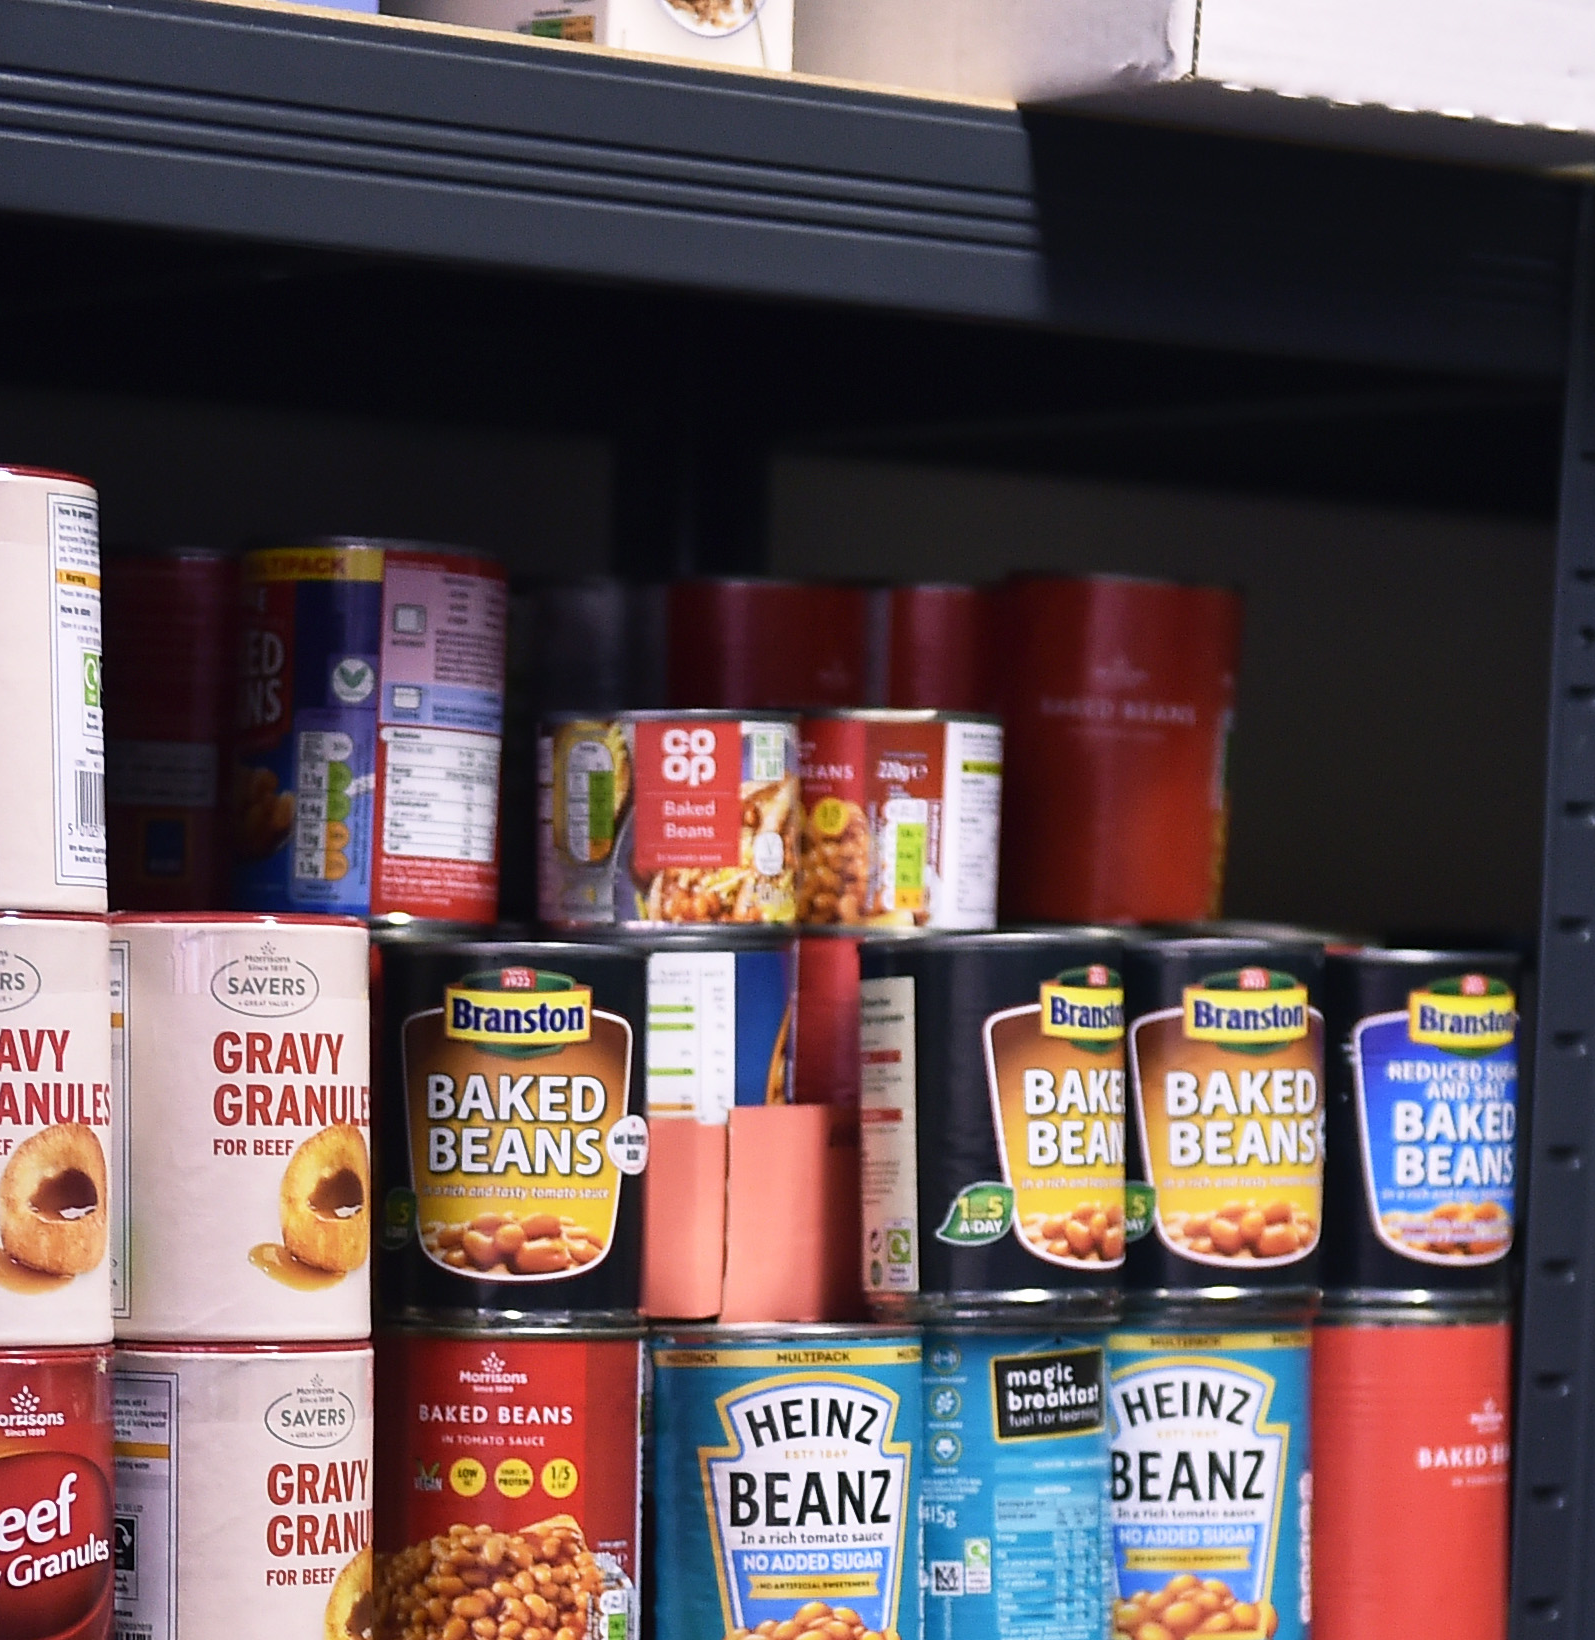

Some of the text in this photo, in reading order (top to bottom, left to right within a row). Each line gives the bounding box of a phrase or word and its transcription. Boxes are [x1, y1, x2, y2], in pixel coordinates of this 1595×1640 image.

[663, 801, 716, 817] Baked
[663, 823, 715, 839] Beans
[227, 977, 306, 996] SAVERS
[505, 976, 531, 988] 1922
[453, 997, 586, 1034] Branston
[1193, 999, 1305, 1031] Branston
[213, 1031, 344, 1075] GRAVY
[1387, 1062, 1482, 1082] REDUCED
[426, 1073, 606, 1123] BAKED
[1165, 1069, 1318, 1117] BAKED
[1427, 1082, 1470, 1100] AND
[213, 1138, 295, 1156] FOR BEEF
[428, 1126, 604, 1176] BEANS
[1169, 1119, 1317, 1168] BEANS
[443, 1186, 610, 1200] rich and tasty tomato sauce
[776, 1353, 851, 1363] MULTIPACK
[459, 1370, 529, 1385] Morrisons
[1007, 1362, 1075, 1392] magic
[1008, 1383, 1100, 1412] breakfast
[1120, 1380, 1252, 1428] HEINZ
[281, 1408, 346, 1428] SAVERS
[418, 1404, 574, 1425] BAKED BEANS
[744, 1397, 880, 1449] HEINZ
[1009, 1406, 1100, 1427] fuel for learning
[4, 1428, 26, 1437] Since
[457, 1435, 506, 1446] TOMATO
[509, 1436, 546, 1447] SAUCE
[266, 1458, 369, 1507] GRAVY
[457, 1467, 478, 1479] LOW
[498, 1477, 531, 1487] PROTEIN
[1111, 1449, 1266, 1502] BEANZ
[728, 1469, 892, 1528] BEANZ
[1142, 1505, 1169, 1519] rich
[1172, 1506, 1219, 1519] tomato
[1222, 1507, 1257, 1518] sauce
[741, 1530, 885, 1545] In a rich tomato sauce
[1119, 1526, 1256, 1546] NO ADDED SUGAR
[7, 1532, 110, 1588] Granules
[743, 1551, 884, 1571] NO ADDED SUGAR
[266, 1567, 337, 1587] FOR BEEF
